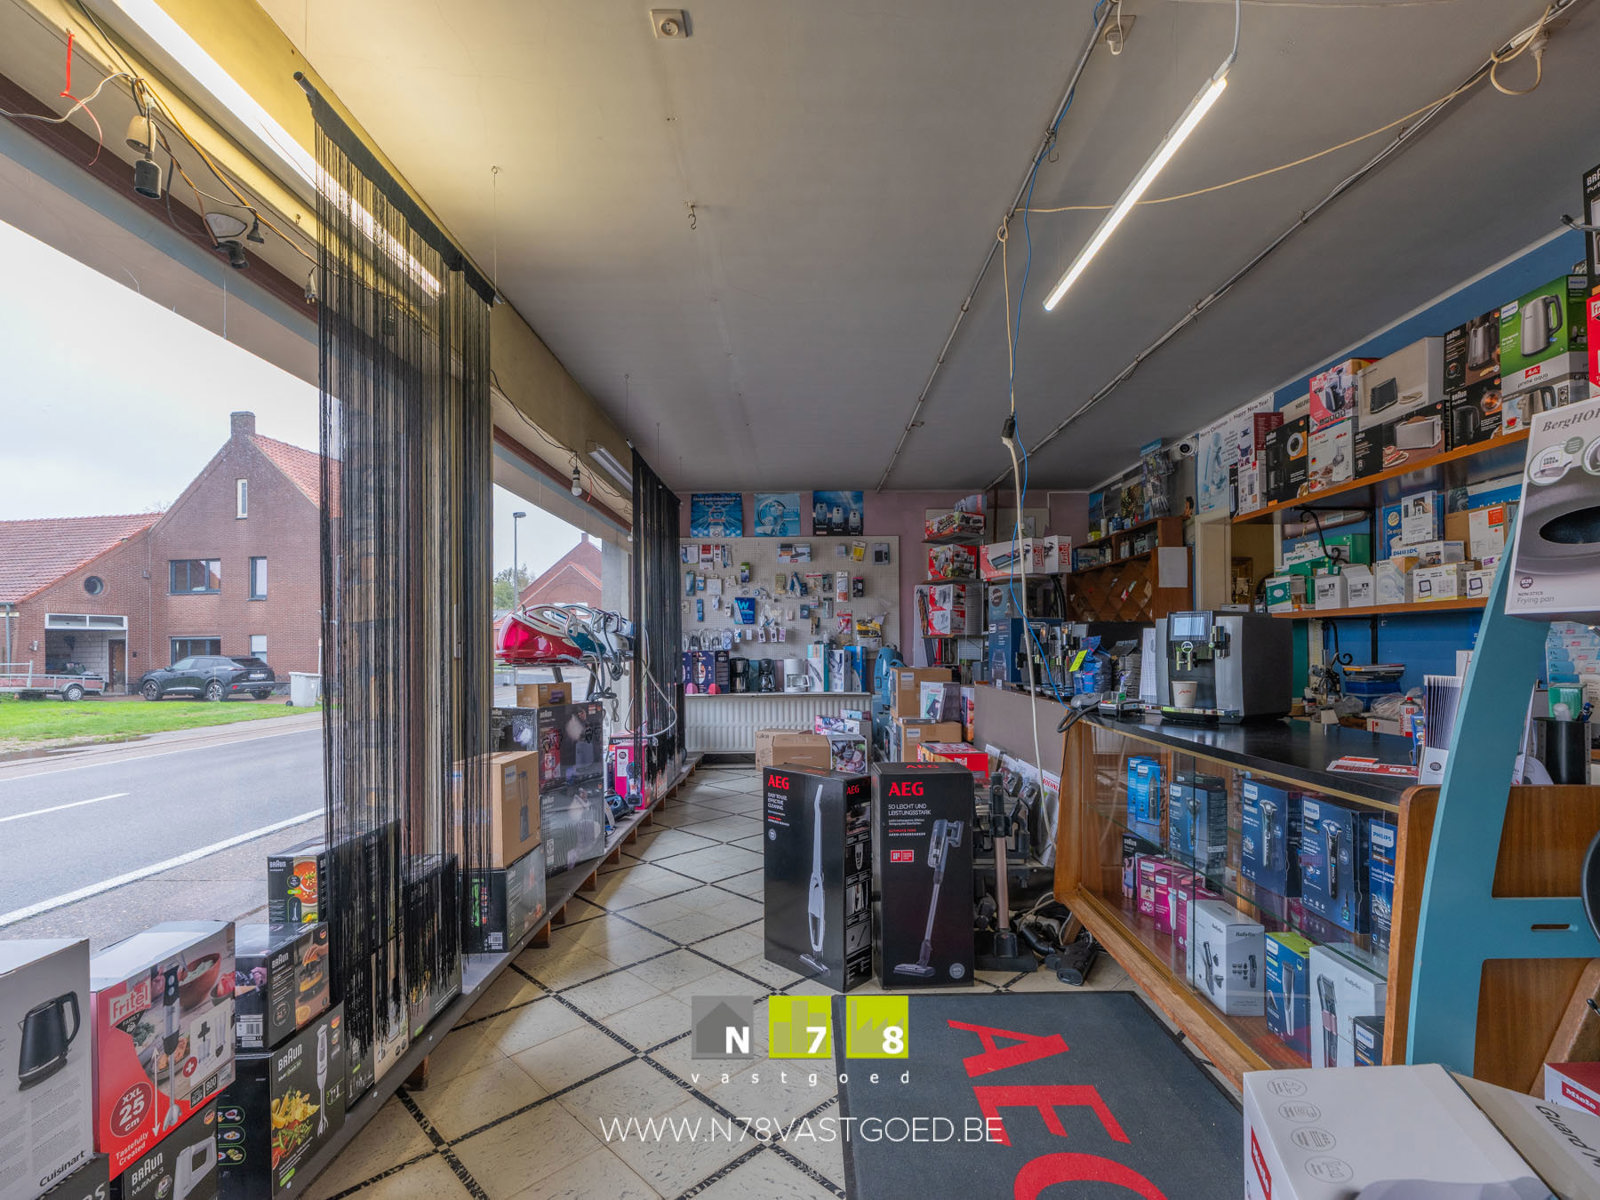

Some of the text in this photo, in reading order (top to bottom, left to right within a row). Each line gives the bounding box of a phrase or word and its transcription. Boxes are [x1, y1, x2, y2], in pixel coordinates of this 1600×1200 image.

[1516, 596, 1555, 605] Frying pan
[767, 774, 790, 790] AEG
[846, 785, 860, 795] AEG
[888, 781, 924, 797] AEG
[1373, 831, 1393, 842] PHILIPS
[271, 952, 289, 969] BRAUN
[113, 984, 148, 1019] Fritel
[278, 1044, 303, 1072] BRAUN
[122, 1087, 142, 1105] XXL
[1566, 1088, 1596, 1110] Miele
[119, 1094, 145, 1127] 25
[125, 1117, 140, 1131] cm
[1536, 1105, 1597, 1152] Guard
[115, 1132, 149, 1160] Tastefully
[119, 1141, 146, 1166] Created
[40, 1150, 87, 1187] Cuisinart
[131, 1152, 163, 1186] BRAUN
